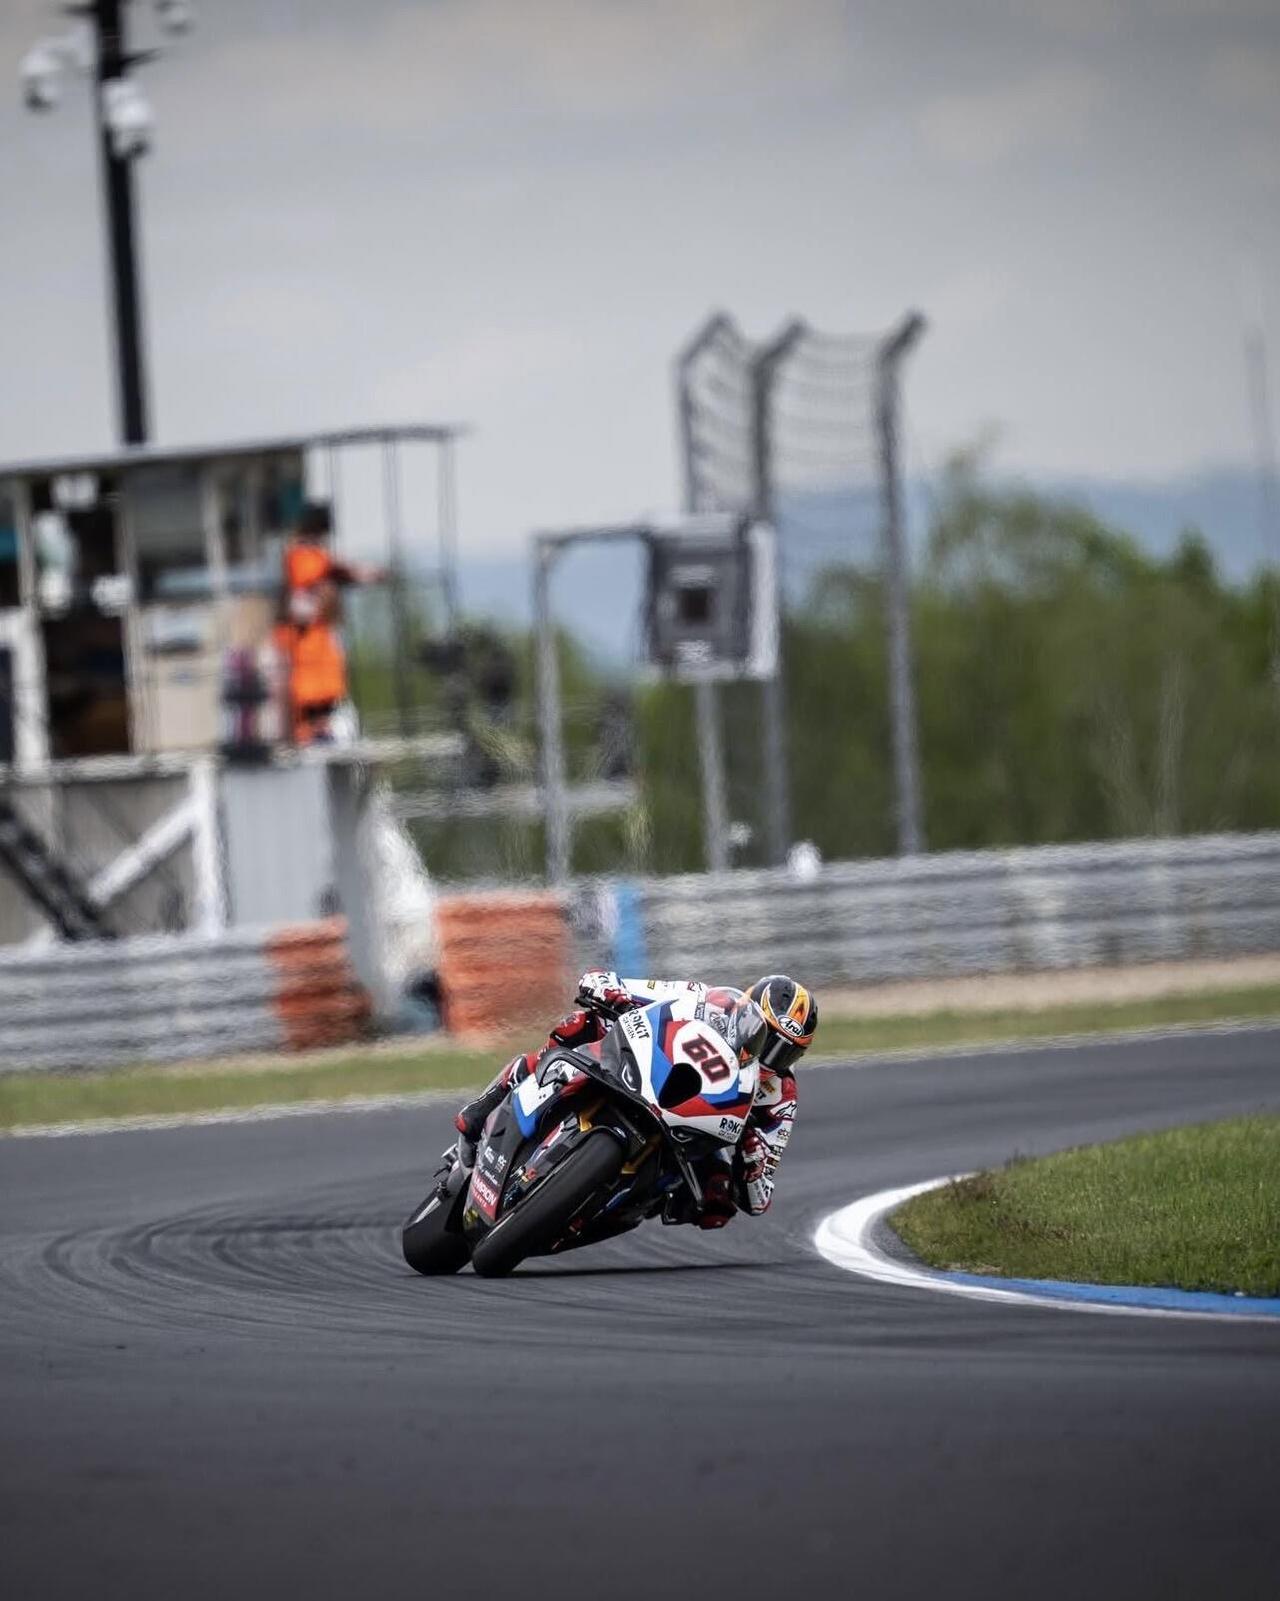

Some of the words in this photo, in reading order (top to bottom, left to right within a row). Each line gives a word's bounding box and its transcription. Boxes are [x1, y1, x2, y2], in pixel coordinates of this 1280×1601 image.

[781, 1018, 803, 1036] Arai
[681, 1033, 730, 1084] 60
[720, 1117, 743, 1135] ROKi
